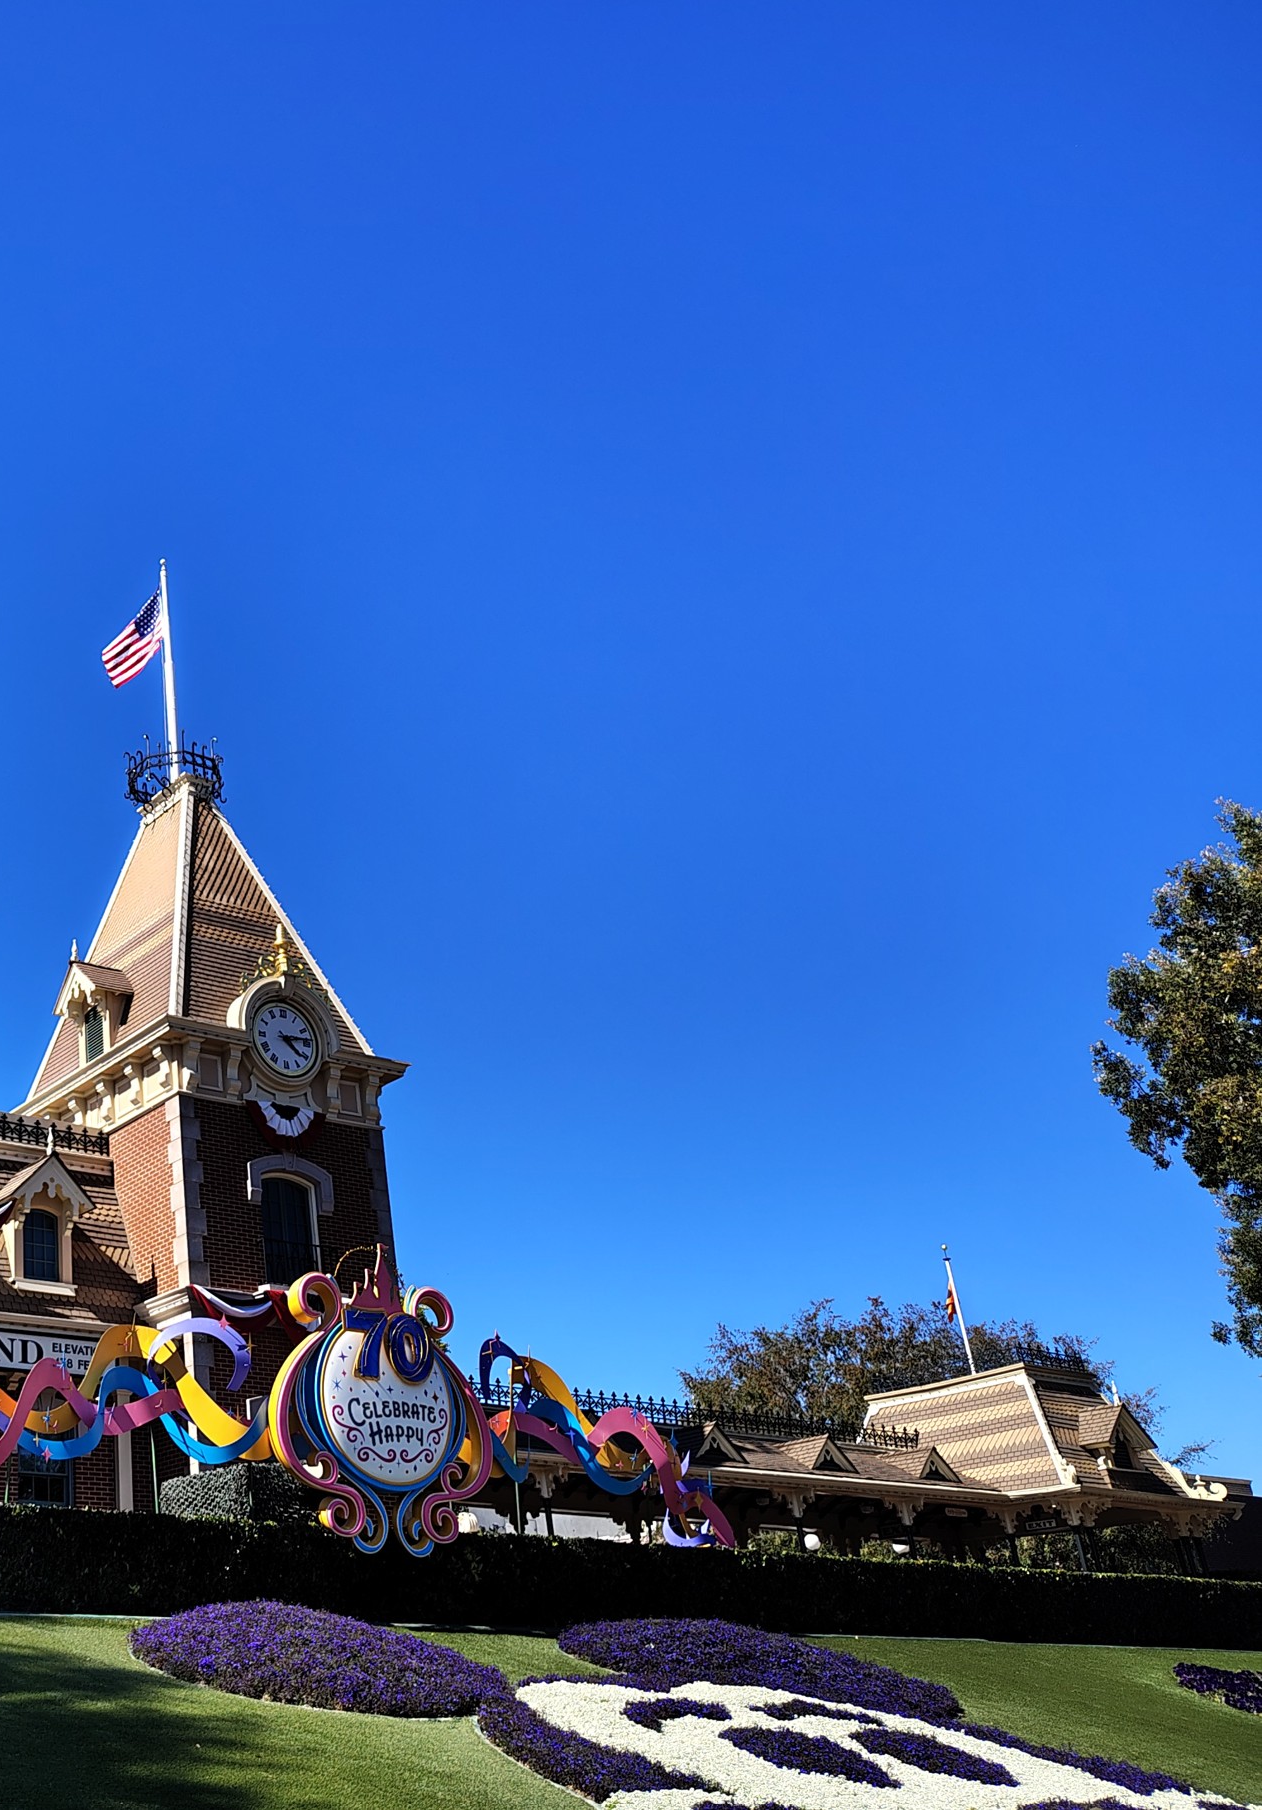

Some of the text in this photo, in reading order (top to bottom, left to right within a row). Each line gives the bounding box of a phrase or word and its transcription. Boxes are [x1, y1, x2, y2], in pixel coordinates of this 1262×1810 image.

[52, 1342, 96, 1357] ELEVATI
[341, 1307, 434, 1384] 70
[78, 1359, 90, 1370] FE
[347, 1397, 437, 1427] CELEBRATE
[368, 1420, 424, 1447] HAPPY
